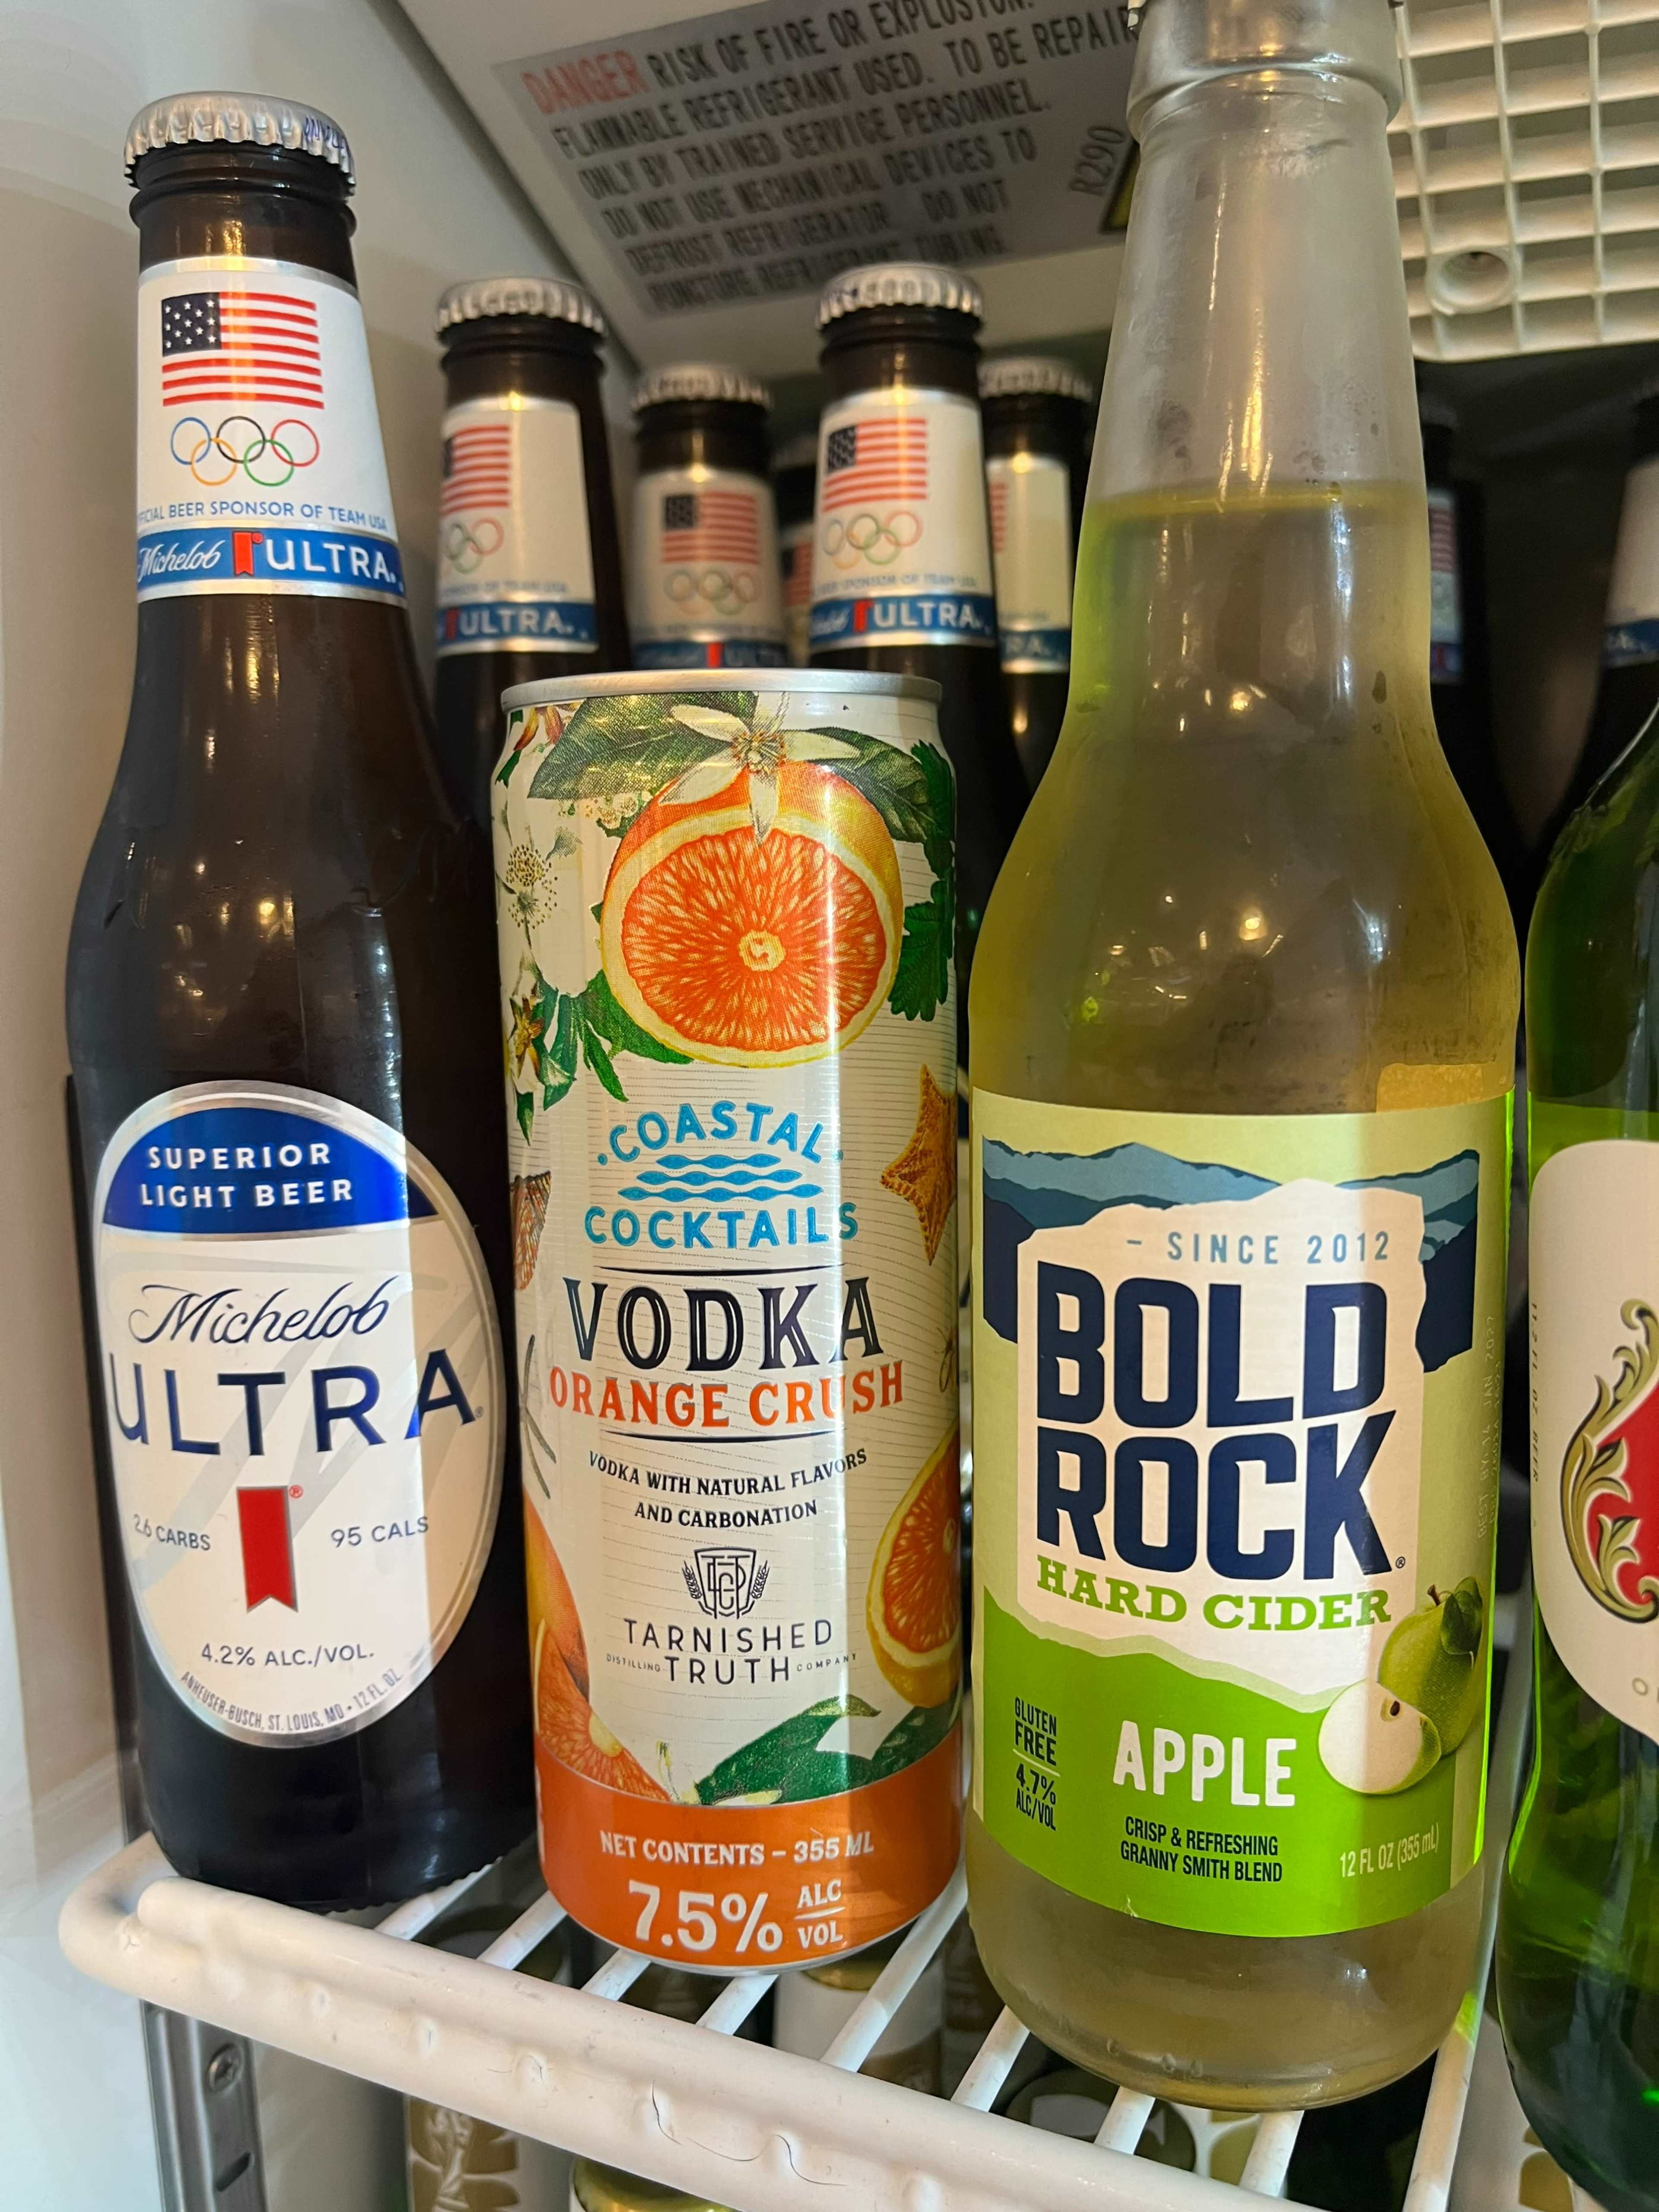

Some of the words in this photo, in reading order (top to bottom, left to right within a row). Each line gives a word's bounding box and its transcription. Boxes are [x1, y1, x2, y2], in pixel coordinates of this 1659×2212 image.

[521, 50, 648, 115] DANGER
[646, 44, 718, 88] RISK
[715, 34, 749, 73] OF
[754, 18, 826, 65] FIRE
[828, 10, 868, 48] OR
[682, 64, 852, 131] REFRIGERANT
[853, 52, 935, 95] USED.
[943, 38, 982, 77] TO
[987, 27, 1027, 68] BE
[638, 153, 675, 188] BY
[674, 132, 780, 181] TRAINED
[783, 107, 895, 159] SERVICE
[895, 78, 1052, 137] PERSONNEL.
[883, 135, 995, 186] DEVICES
[1000, 128, 1037, 164] TO
[1068, 126, 1123, 197] R290
[169, 502, 204, 518] BEER
[210, 501, 294, 516] SPONSOR
[301, 504, 323, 518] OF
[328, 506, 367, 526] TEAM
[369, 515, 388, 532] USA
[138, 540, 226, 583] Michelob
[608, 1100, 823, 1164] COASTAL
[149, 1143, 331, 1170] SUPERIOR
[140, 1184, 235, 1208] LIGHT
[255, 1179, 352, 1207] BEER
[585, 1202, 858, 1249] COCKTAILS
[1167, 1232, 1278, 1265] SINCE
[1307, 1232, 1390, 1264] 2012
[128, 1275, 399, 1344] Michelob
[563, 1276, 884, 1371] VODKA
[1037, 1260, 1388, 1428] BOLD
[109, 1348, 476, 1456] ULTRA
[550, 1365, 730, 1427] ORANGE
[748, 1360, 904, 1427] CRUSH
[589, 1451, 640, 1485] VODKA
[646, 1471, 690, 1495] WITH
[696, 1474, 785, 1496] NATURAL
[791, 1448, 868, 1488] FLAVORS
[1037, 1409, 1396, 1580] ROCK
[331, 1527, 362, 1548] 95
[372, 1516, 429, 1543] CALS
[635, 1502, 672, 1524] AND
[678, 1500, 817, 1529] CARBONATION
[156, 1526, 210, 1551] CARBS
[1036, 1555, 1188, 1623] HARD
[1202, 1589, 1391, 1631] CIDER
[201, 1643, 255, 1665] 4.2%
[265, 1644, 374, 1667] ALC./VOL.
[623, 1618, 832, 1654] TARNISHED
[606, 1653, 661, 1672] DISTILLING
[664, 1656, 790, 1685] TRUTH
[797, 1653, 858, 1672] COMPANY
[180, 1671, 264, 1731] ANHEUSER-BUSCH,
[268, 1714, 284, 1731] ST.
[287, 1712, 324, 1730] LOUIS,
[324, 1703, 345, 1724] MO
[353, 1691, 370, 1709] 12
[1014, 1696, 1057, 1737] GLUTEN
[1015, 1719, 1057, 1766] FREE
[1112, 1720, 1296, 1807] APPLE
[1016, 1763, 1056, 1805] 4.7%
[1016, 1787, 1056, 1831] ALC/VOL
[600, 1831, 637, 1858] NET
[643, 1838, 765, 1866] CONTENTS
[793, 1837, 840, 1863] 355
[845, 1831, 874, 1857] ML
[1125, 1816, 1167, 1843] CRISP
[1170, 1827, 1182, 1847] &
[1186, 1830, 1278, 1856] REFRESHING
[1340, 1853, 1356, 1878] 12
[1359, 1849, 1374, 1873] FL
[1378, 1842, 1394, 1869] OZ
[1398, 1834, 1421, 1871] (355
[1421, 1822, 1439, 1853] mL)
[1121, 1840, 1179, 1872] GRANNY
[1182, 1857, 1230, 1879] SMITH
[1234, 1862, 1283, 1883] BLEND
[629, 1880, 783, 1953] 7.5%
[797, 1879, 841, 1909] ALC
[798, 1920, 843, 1949] VOL
